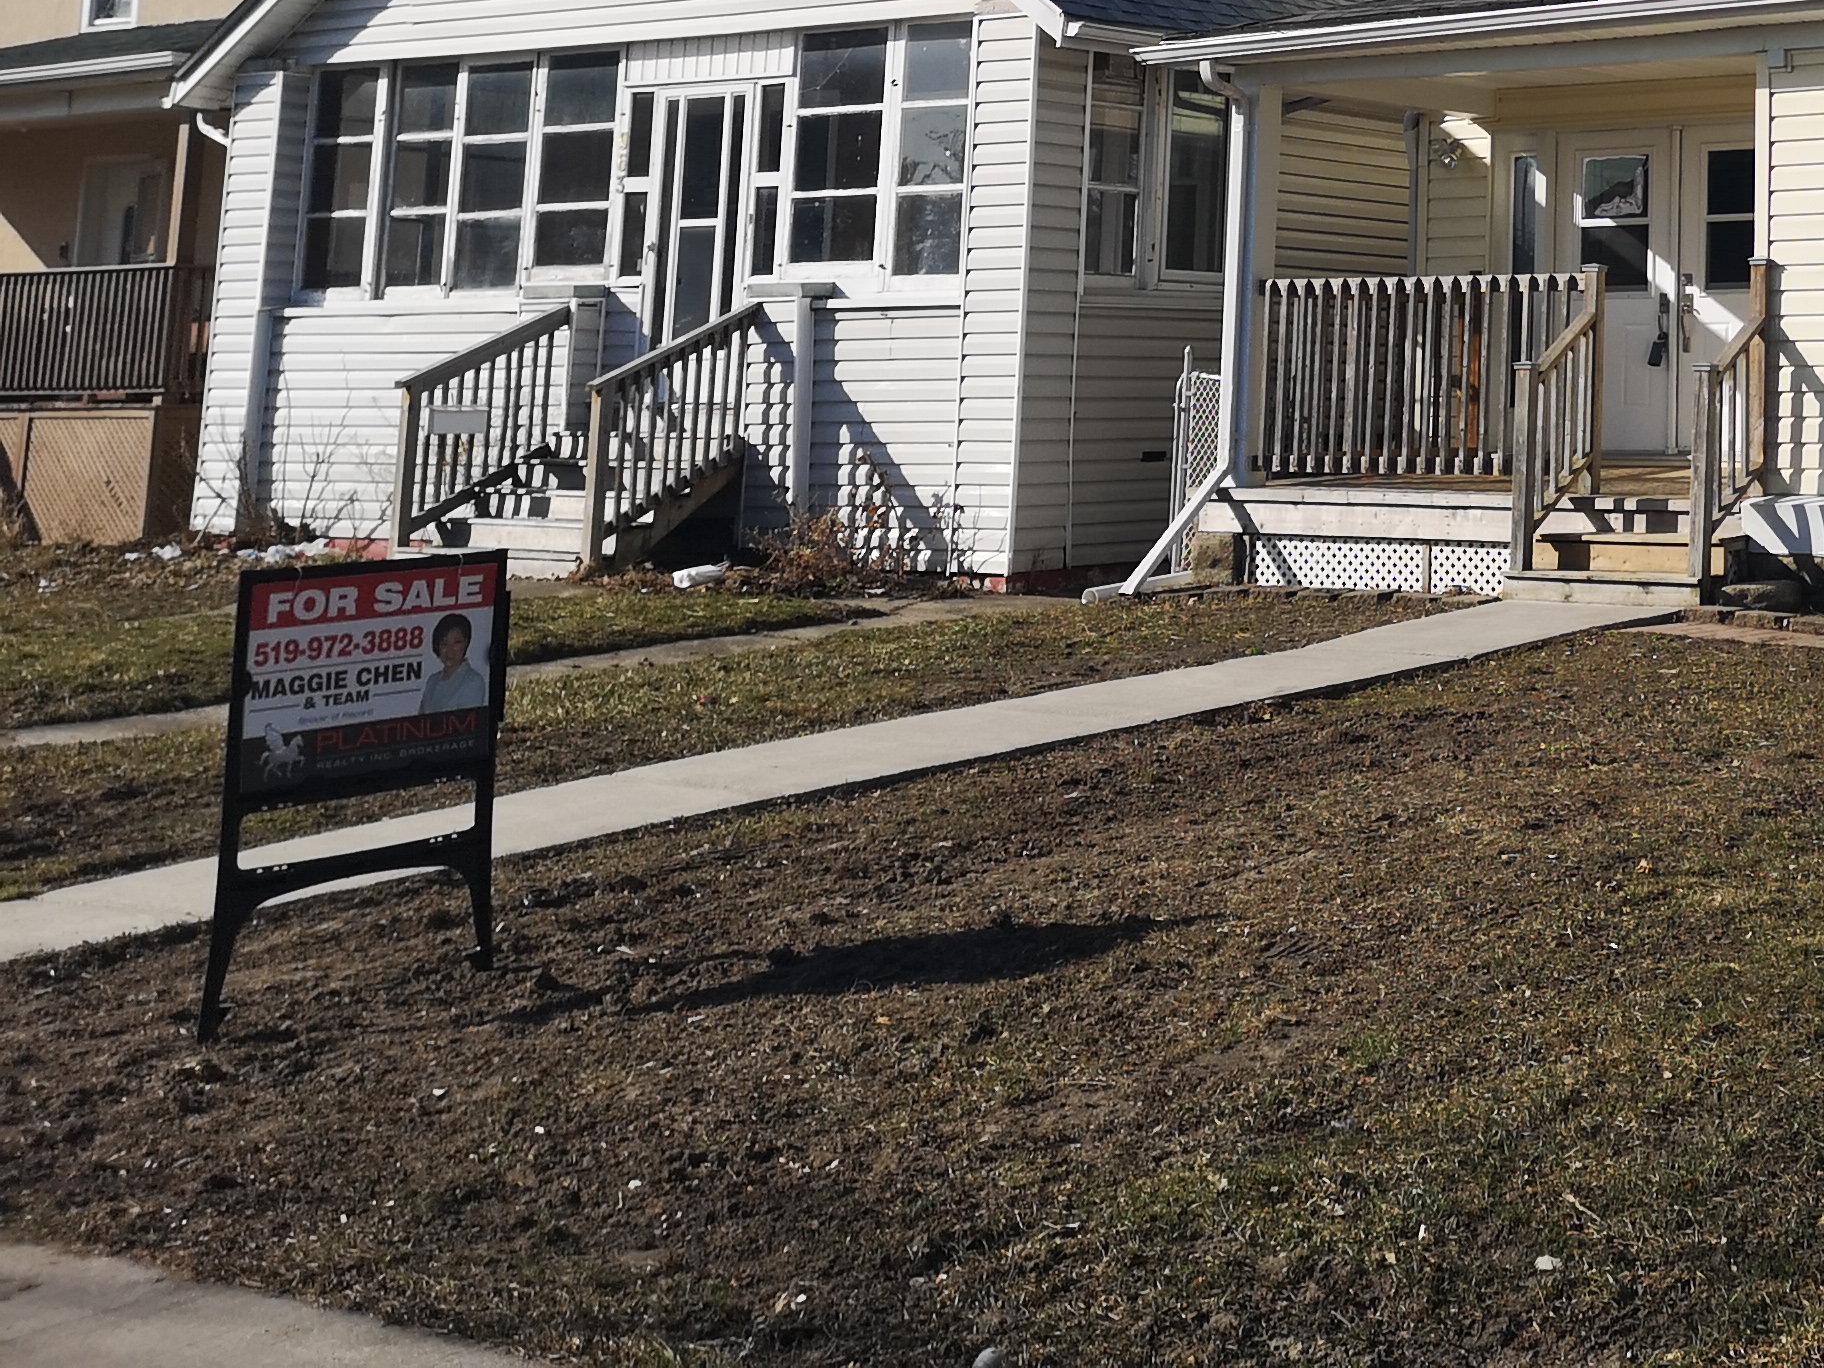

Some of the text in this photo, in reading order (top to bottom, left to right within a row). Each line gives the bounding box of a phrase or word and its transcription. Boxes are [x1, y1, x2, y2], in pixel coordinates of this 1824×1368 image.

[266, 574, 484, 624] FOR SALE
[253, 625, 425, 668] 519-972-3888
[251, 661, 423, 701] MAGGIE CHEN
[303, 690, 370, 710] & TEAM
[316, 712, 477, 754] PLATINUM
[316, 755, 366, 770] REALTY
[399, 739, 476, 758] BROKERAGE
